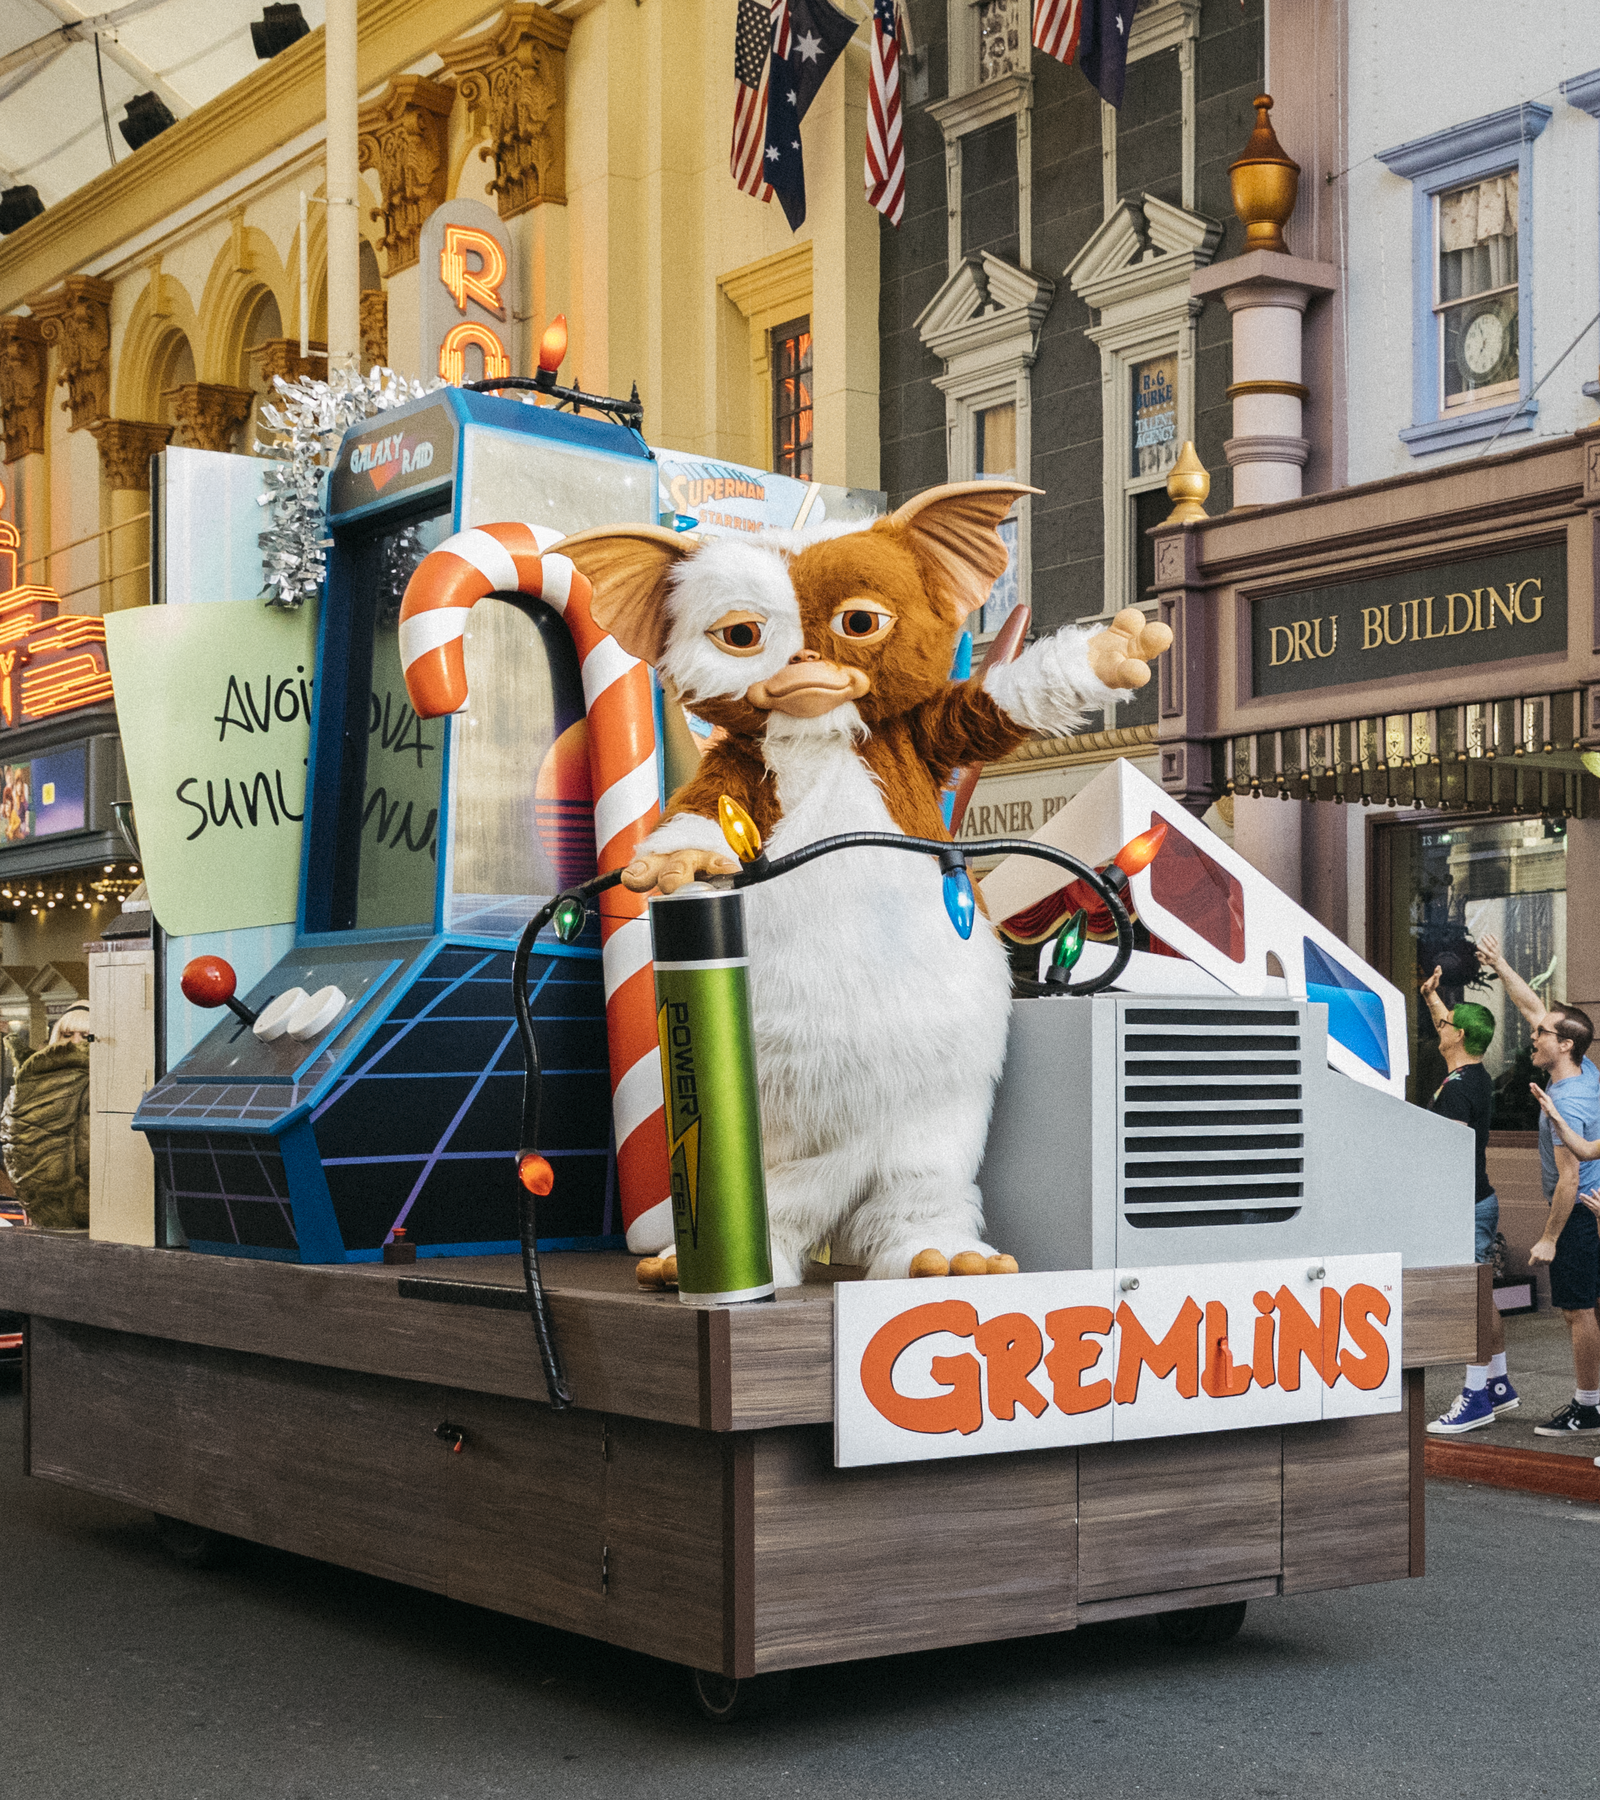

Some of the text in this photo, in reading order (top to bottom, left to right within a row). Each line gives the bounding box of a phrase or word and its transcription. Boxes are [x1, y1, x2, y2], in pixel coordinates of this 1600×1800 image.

[1136, 384, 1173, 410] BURKE
[1135, 411, 1175, 434] TALENT
[1135, 425, 1176, 449] AGENCY
[350, 432, 434, 475] GALAXY RAID
[670, 475, 766, 515] SUPERMAN
[1269, 577, 1544, 667] DRU BUILDING
[668, 1002, 699, 1116] POWER
